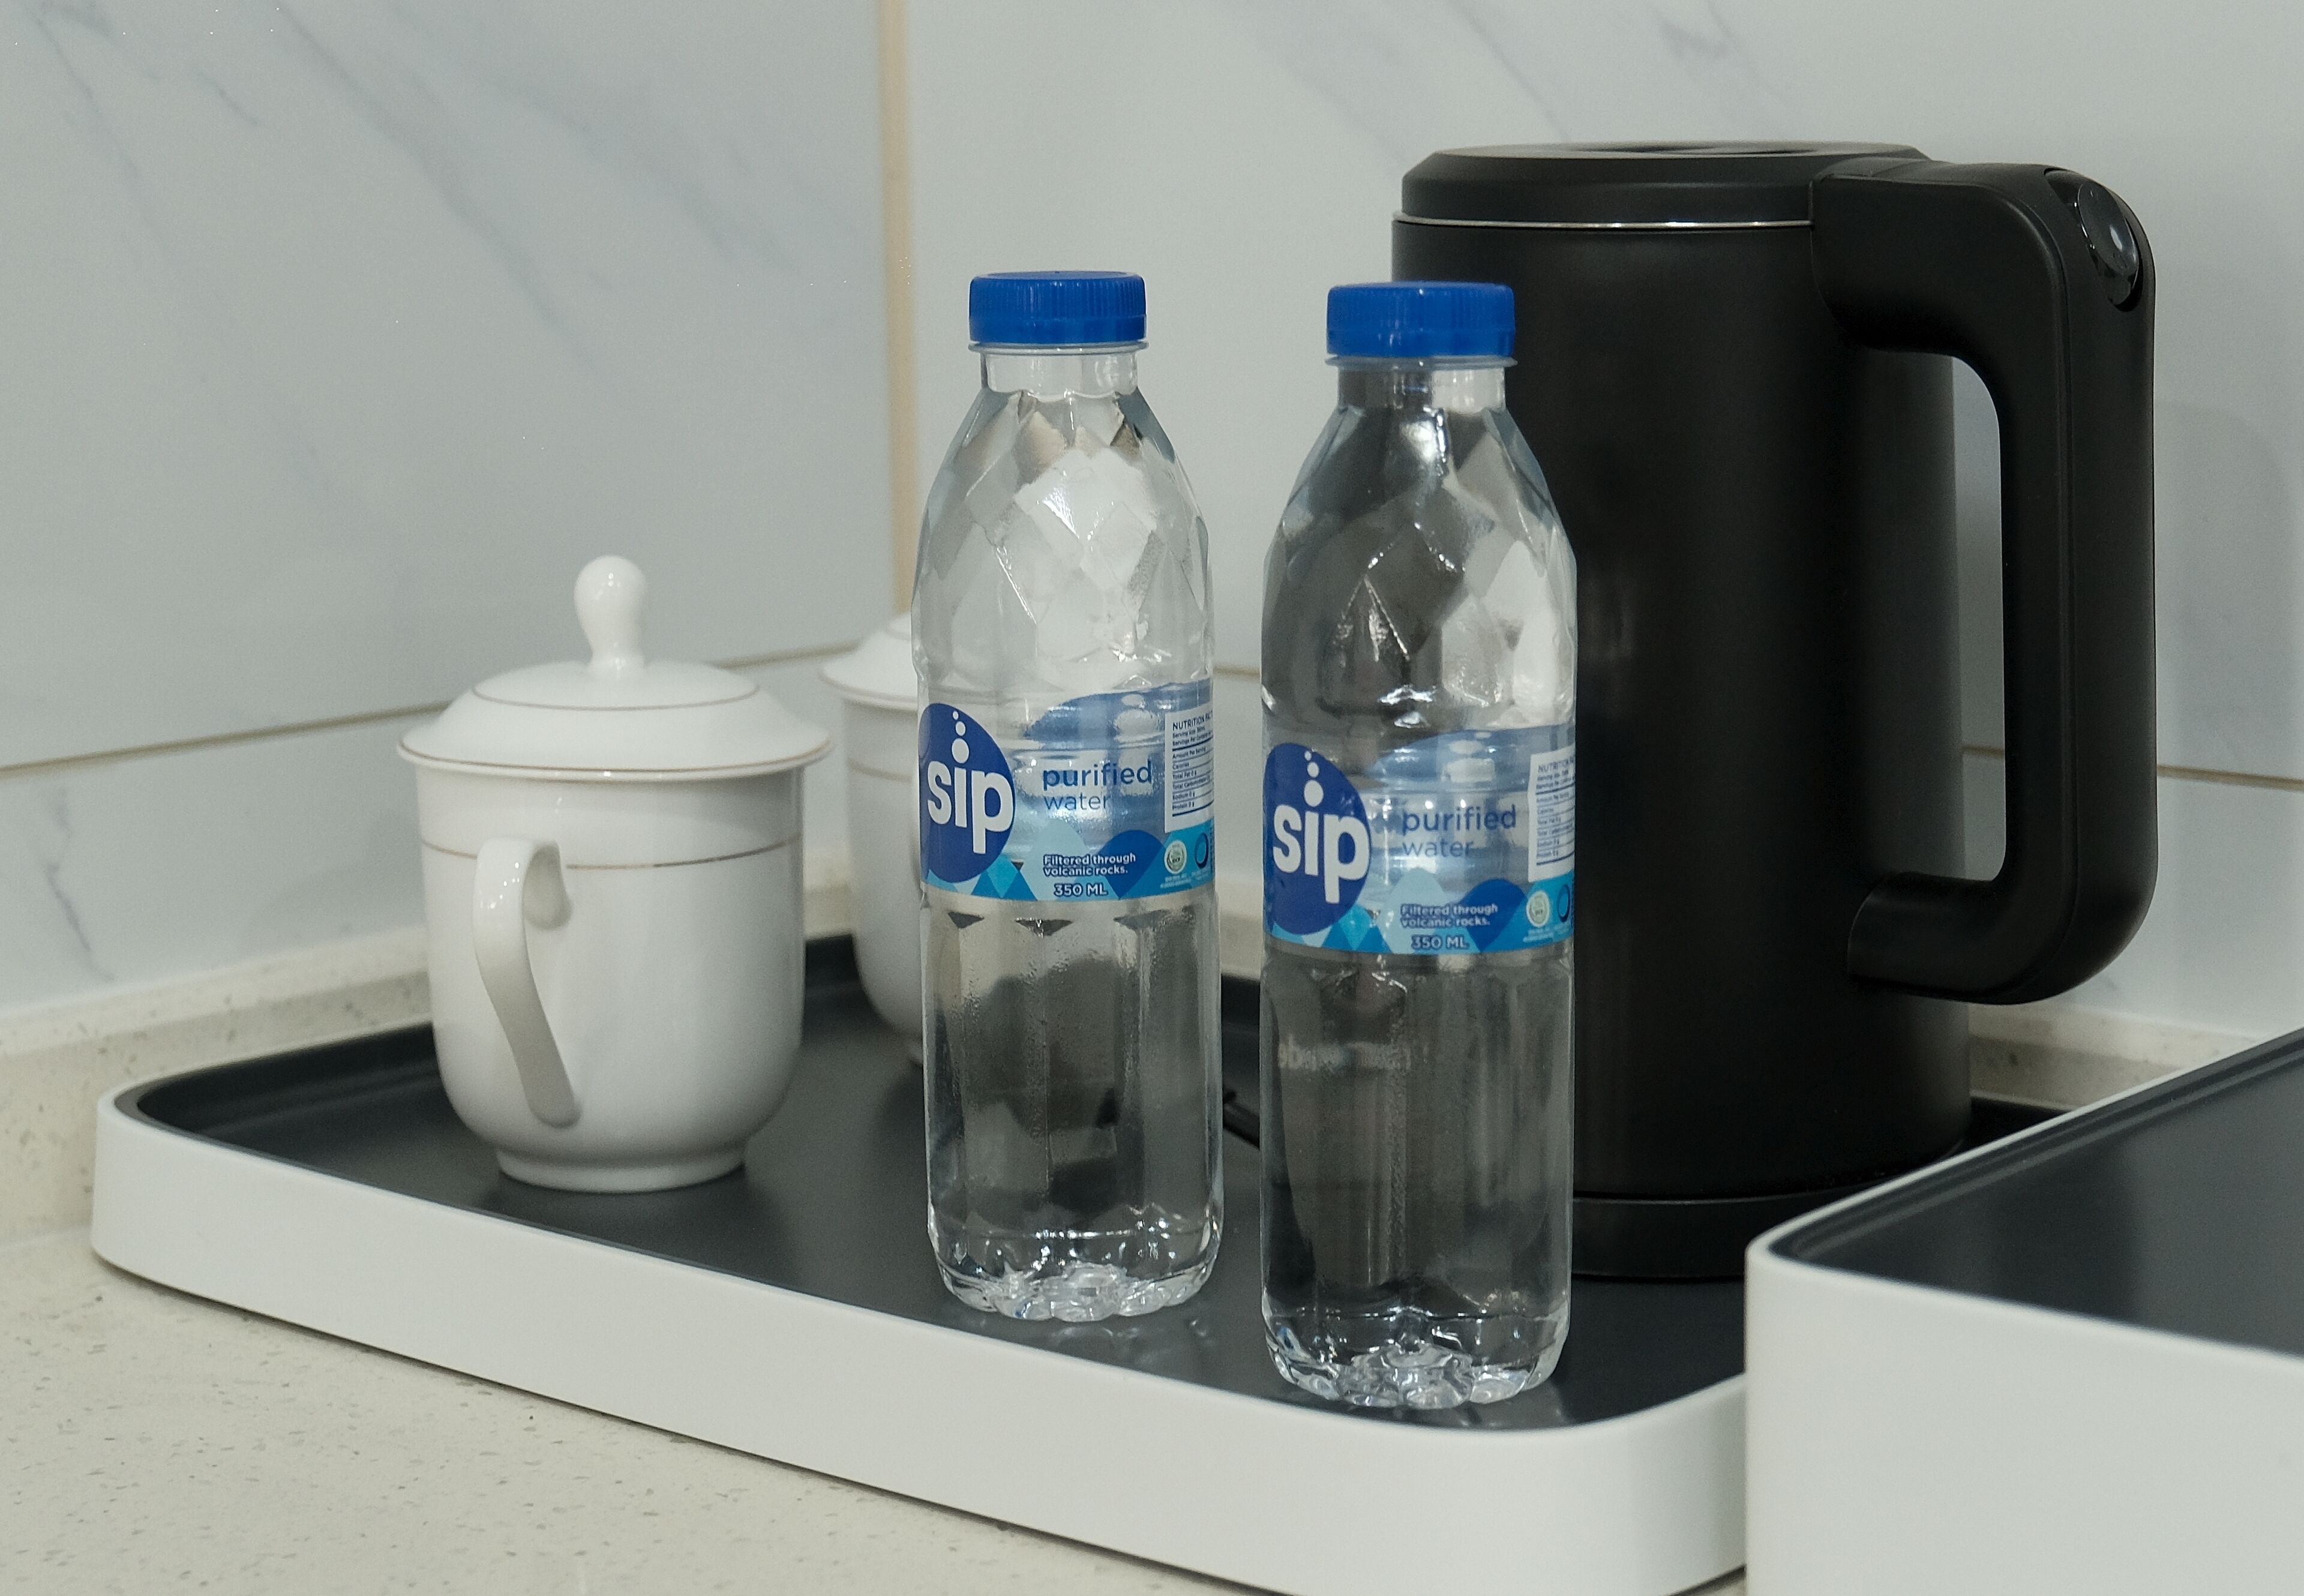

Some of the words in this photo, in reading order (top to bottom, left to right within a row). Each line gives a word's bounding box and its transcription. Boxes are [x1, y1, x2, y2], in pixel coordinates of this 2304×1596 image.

[1172, 715, 1205, 731] NUTRITION
[1043, 758, 1152, 791] purified
[927, 738, 1014, 854] sip
[1043, 791, 1111, 811] water
[1402, 804, 1516, 836] purified
[1272, 780, 1370, 904] sip
[1402, 838, 1474, 857] water
[1044, 854, 1090, 865] Filtered
[1093, 853, 1136, 865] through
[1044, 866, 1092, 876] volcanic
[1096, 865, 1128, 875] rocks.
[1054, 883, 1083, 897] 350
[1087, 883, 1108, 896] ML
[1401, 904, 1450, 916] Filtered
[1453, 903, 1498, 916] through
[1401, 916, 1453, 928] volcanic
[1456, 916, 1490, 926] rocks.
[1412, 935, 1442, 950] 350
[1447, 935, 1469, 949] ML
